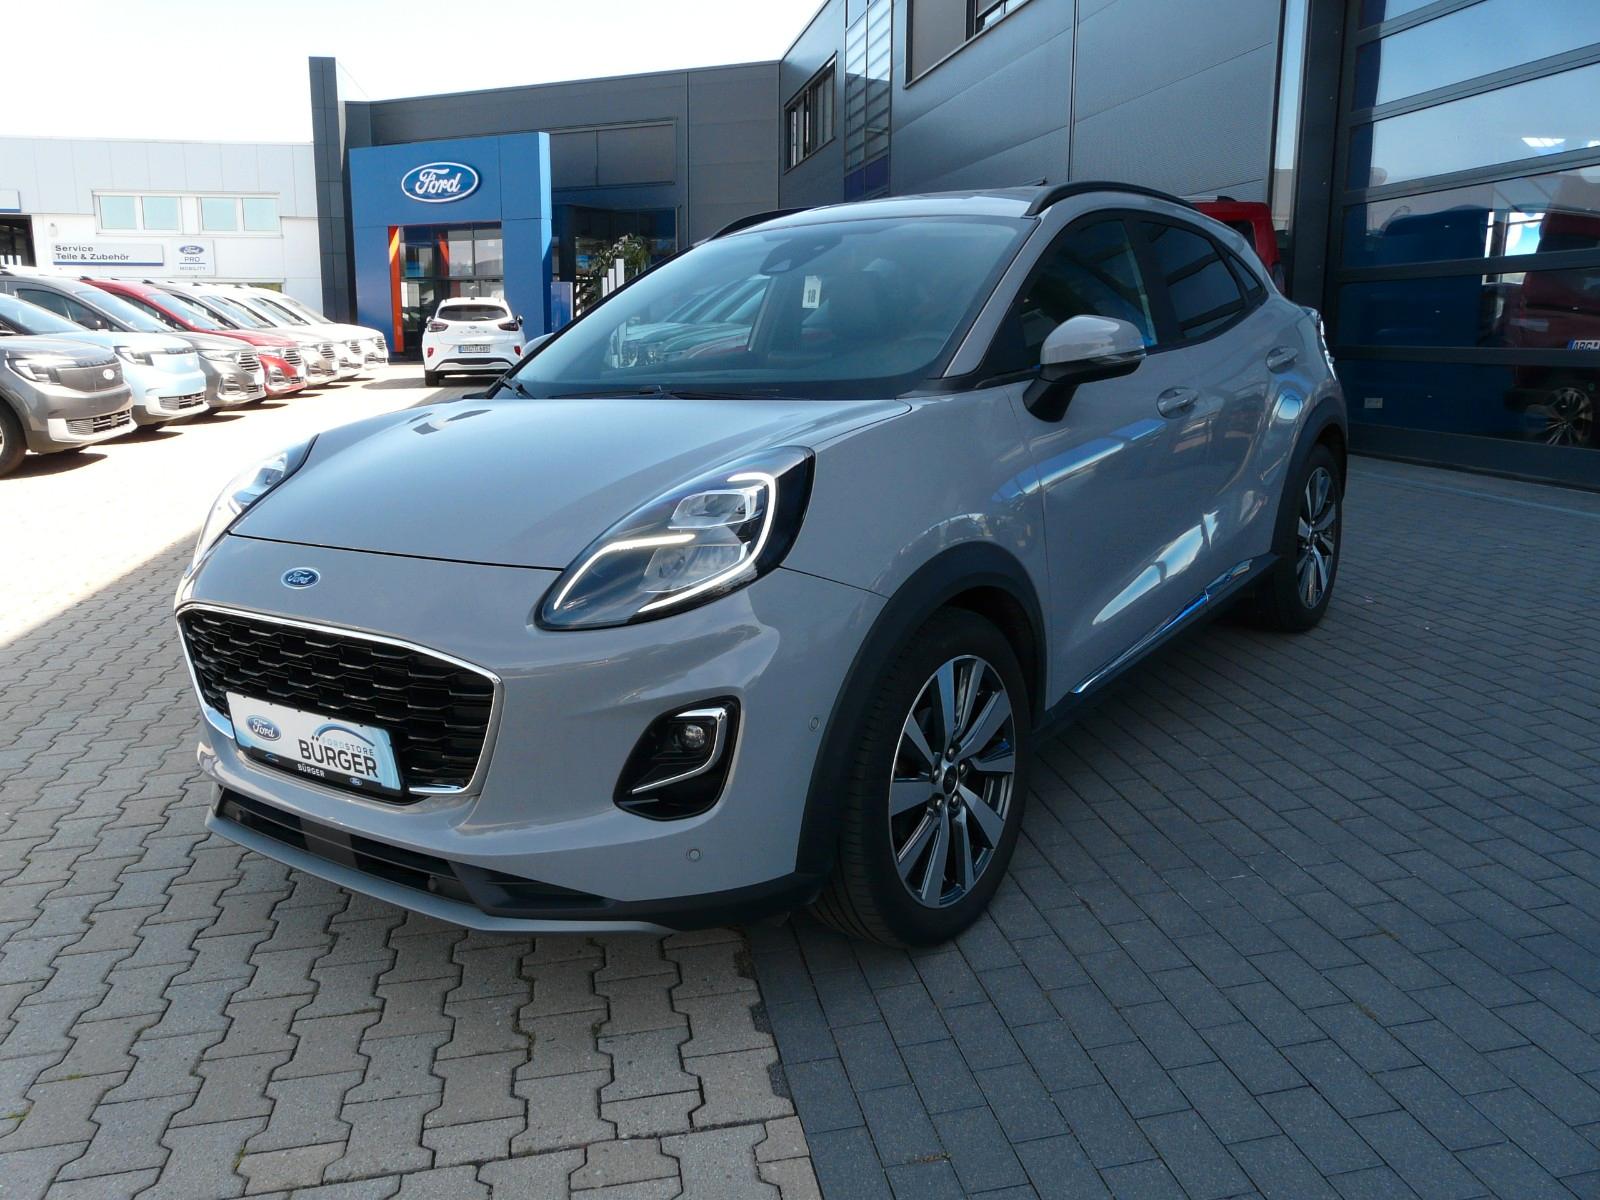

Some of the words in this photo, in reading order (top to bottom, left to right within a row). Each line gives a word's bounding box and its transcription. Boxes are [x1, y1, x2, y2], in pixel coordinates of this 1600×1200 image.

[415, 168, 462, 194] Ford
[55, 244, 94, 252] Service
[90, 252, 130, 261] Zubehör
[252, 719, 275, 738] Ford
[299, 736, 379, 778] BÜRGER
[298, 763, 326, 778] BÜRGER
